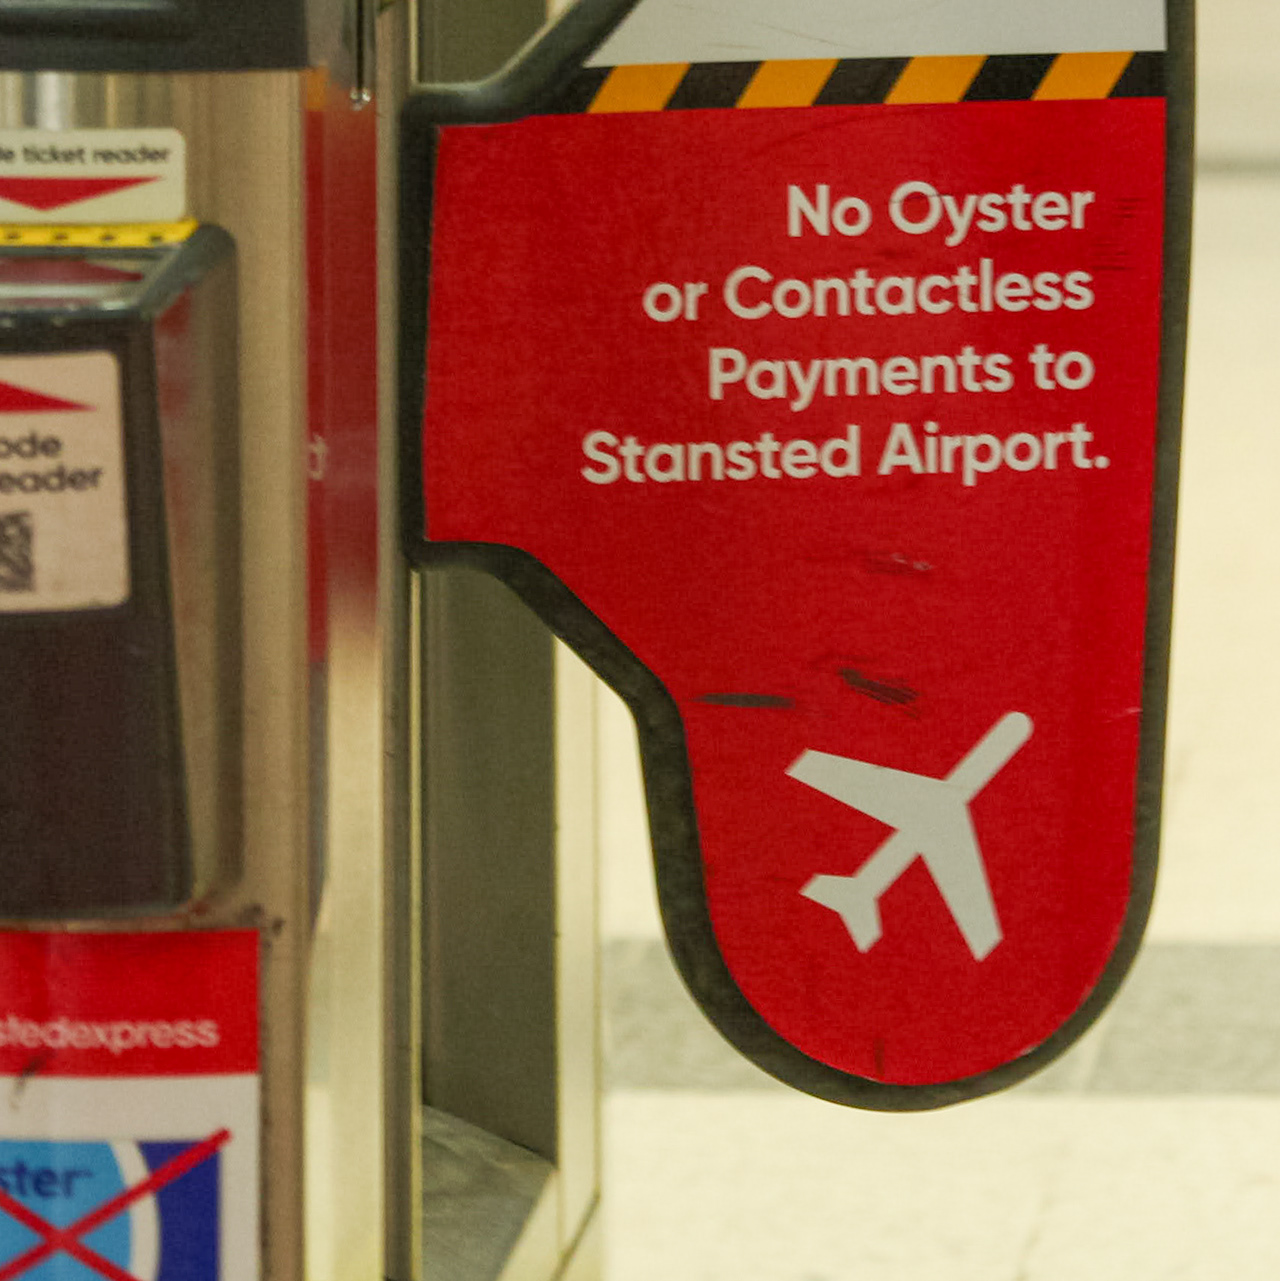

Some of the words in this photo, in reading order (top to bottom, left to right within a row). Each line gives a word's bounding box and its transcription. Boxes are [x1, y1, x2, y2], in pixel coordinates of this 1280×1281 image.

[23, 144, 85, 163] ticket
[93, 144, 170, 164] reader
[788, 183, 872, 238] No
[887, 180, 1095, 247] Oyster
[641, 280, 709, 323] or
[723, 257, 1094, 320] Contactless
[708, 345, 1014, 412] Payments
[1028, 343, 1094, 390] to
[581, 424, 862, 485] Stansted
[878, 420, 1110, 487] Airport.
